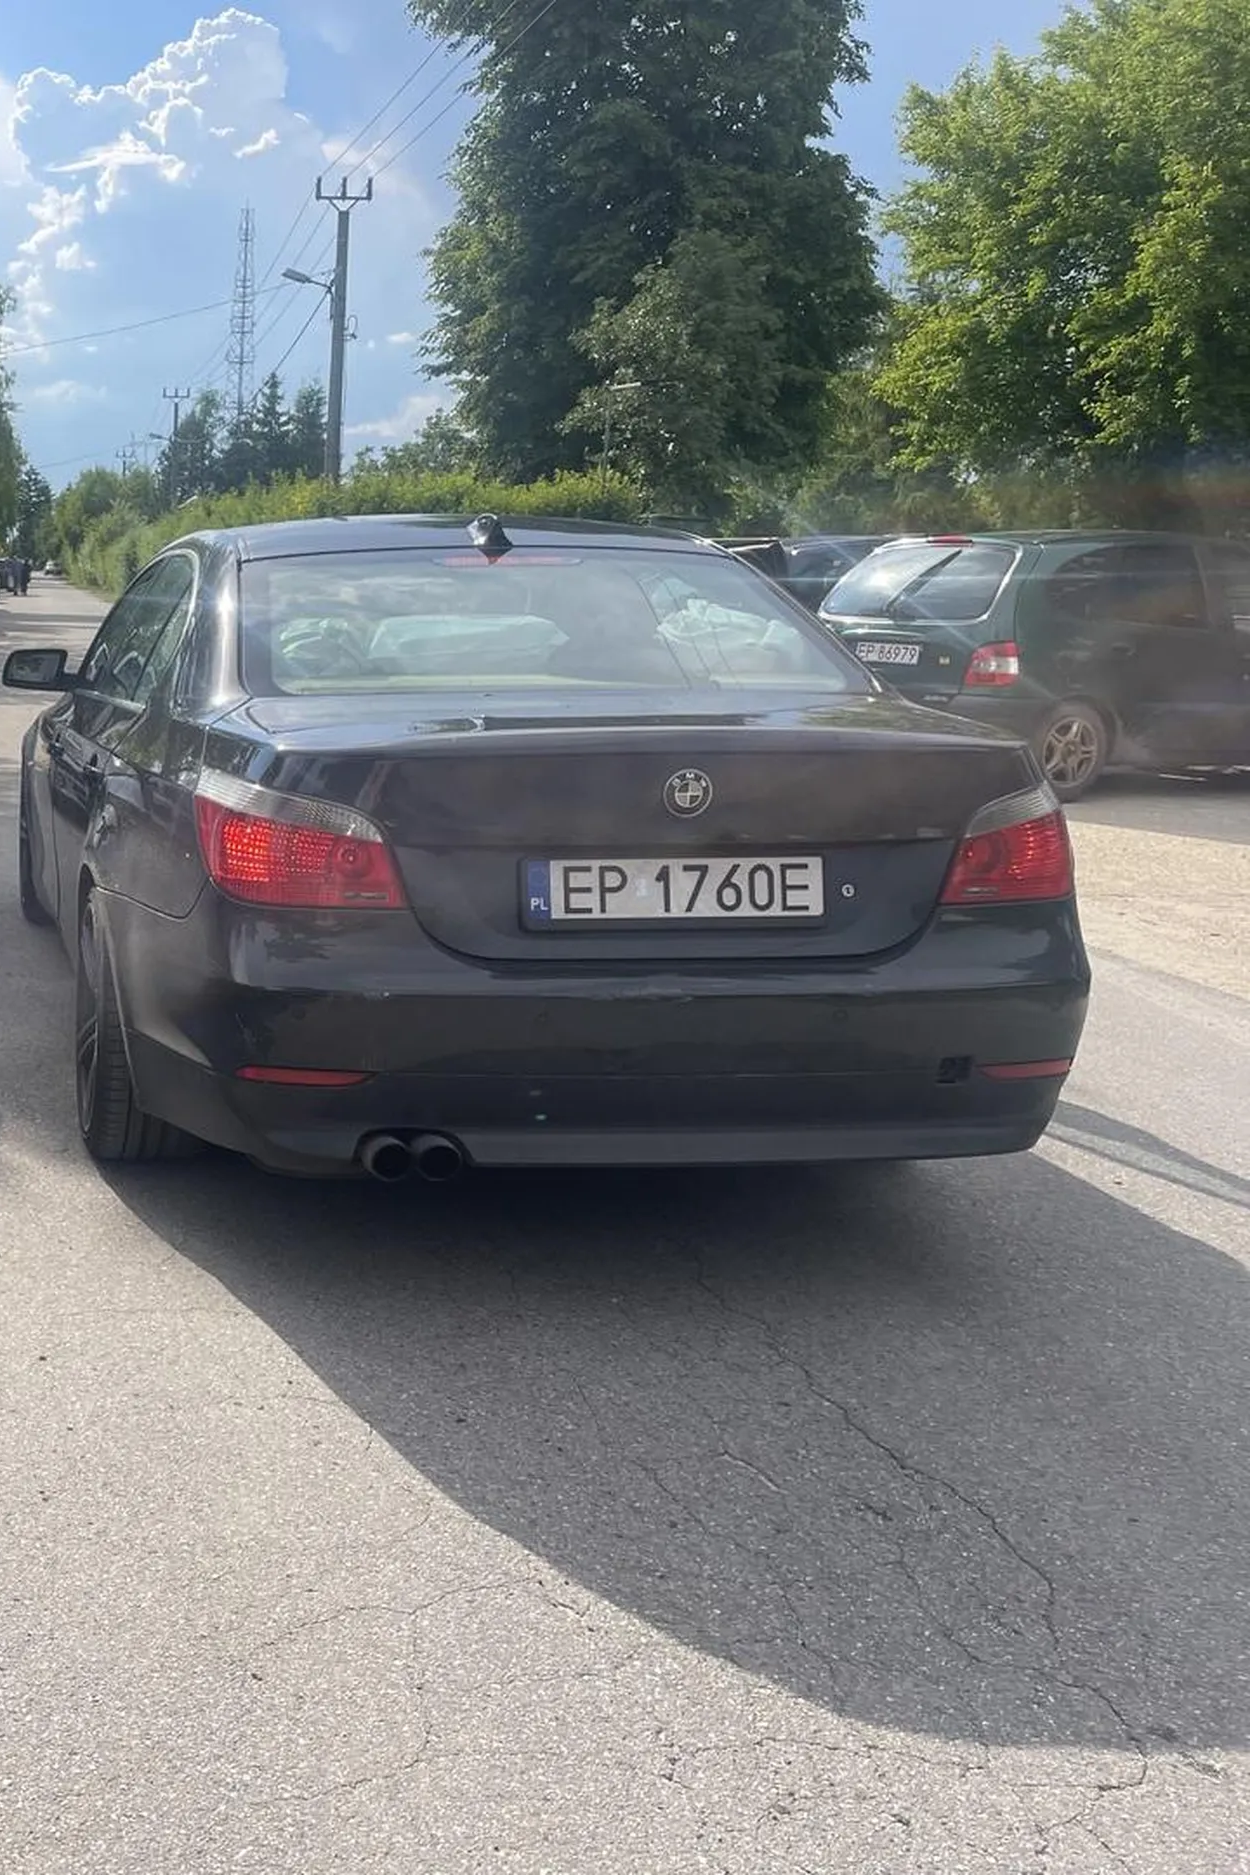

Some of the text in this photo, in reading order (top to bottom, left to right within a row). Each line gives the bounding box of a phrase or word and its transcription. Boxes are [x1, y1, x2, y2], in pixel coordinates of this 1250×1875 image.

[878, 645, 917, 662] 86979
[563, 863, 809, 914] EP 1760E
[530, 898, 548, 911] PL
